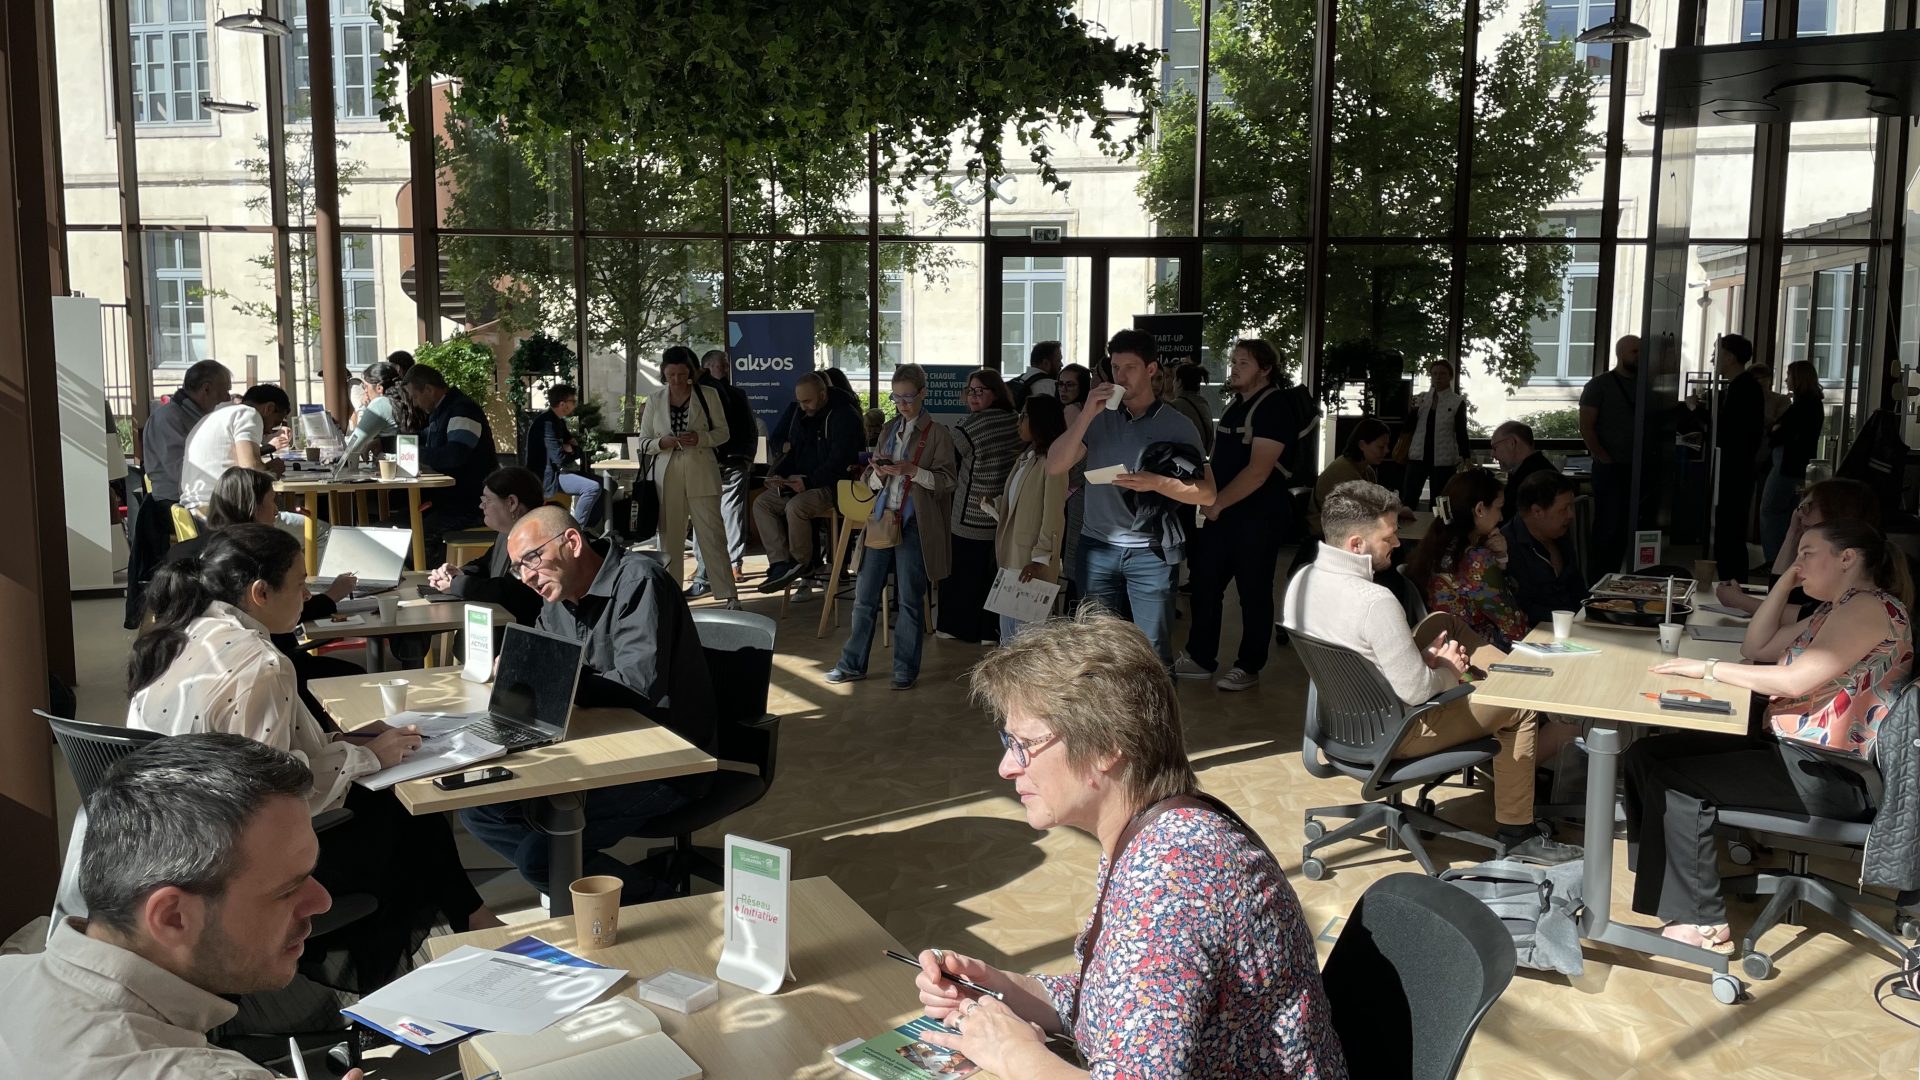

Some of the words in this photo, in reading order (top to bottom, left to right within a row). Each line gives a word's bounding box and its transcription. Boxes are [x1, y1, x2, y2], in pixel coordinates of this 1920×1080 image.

[1154, 334, 1184, 342] TART-UP
[735, 353, 794, 371] akyos
[930, 381, 948, 389] DANS
[924, 398, 933, 406] DE
[934, 398, 942, 406] LA
[741, 893, 771, 911] Réseau
[740, 904, 778, 924] Initiative
